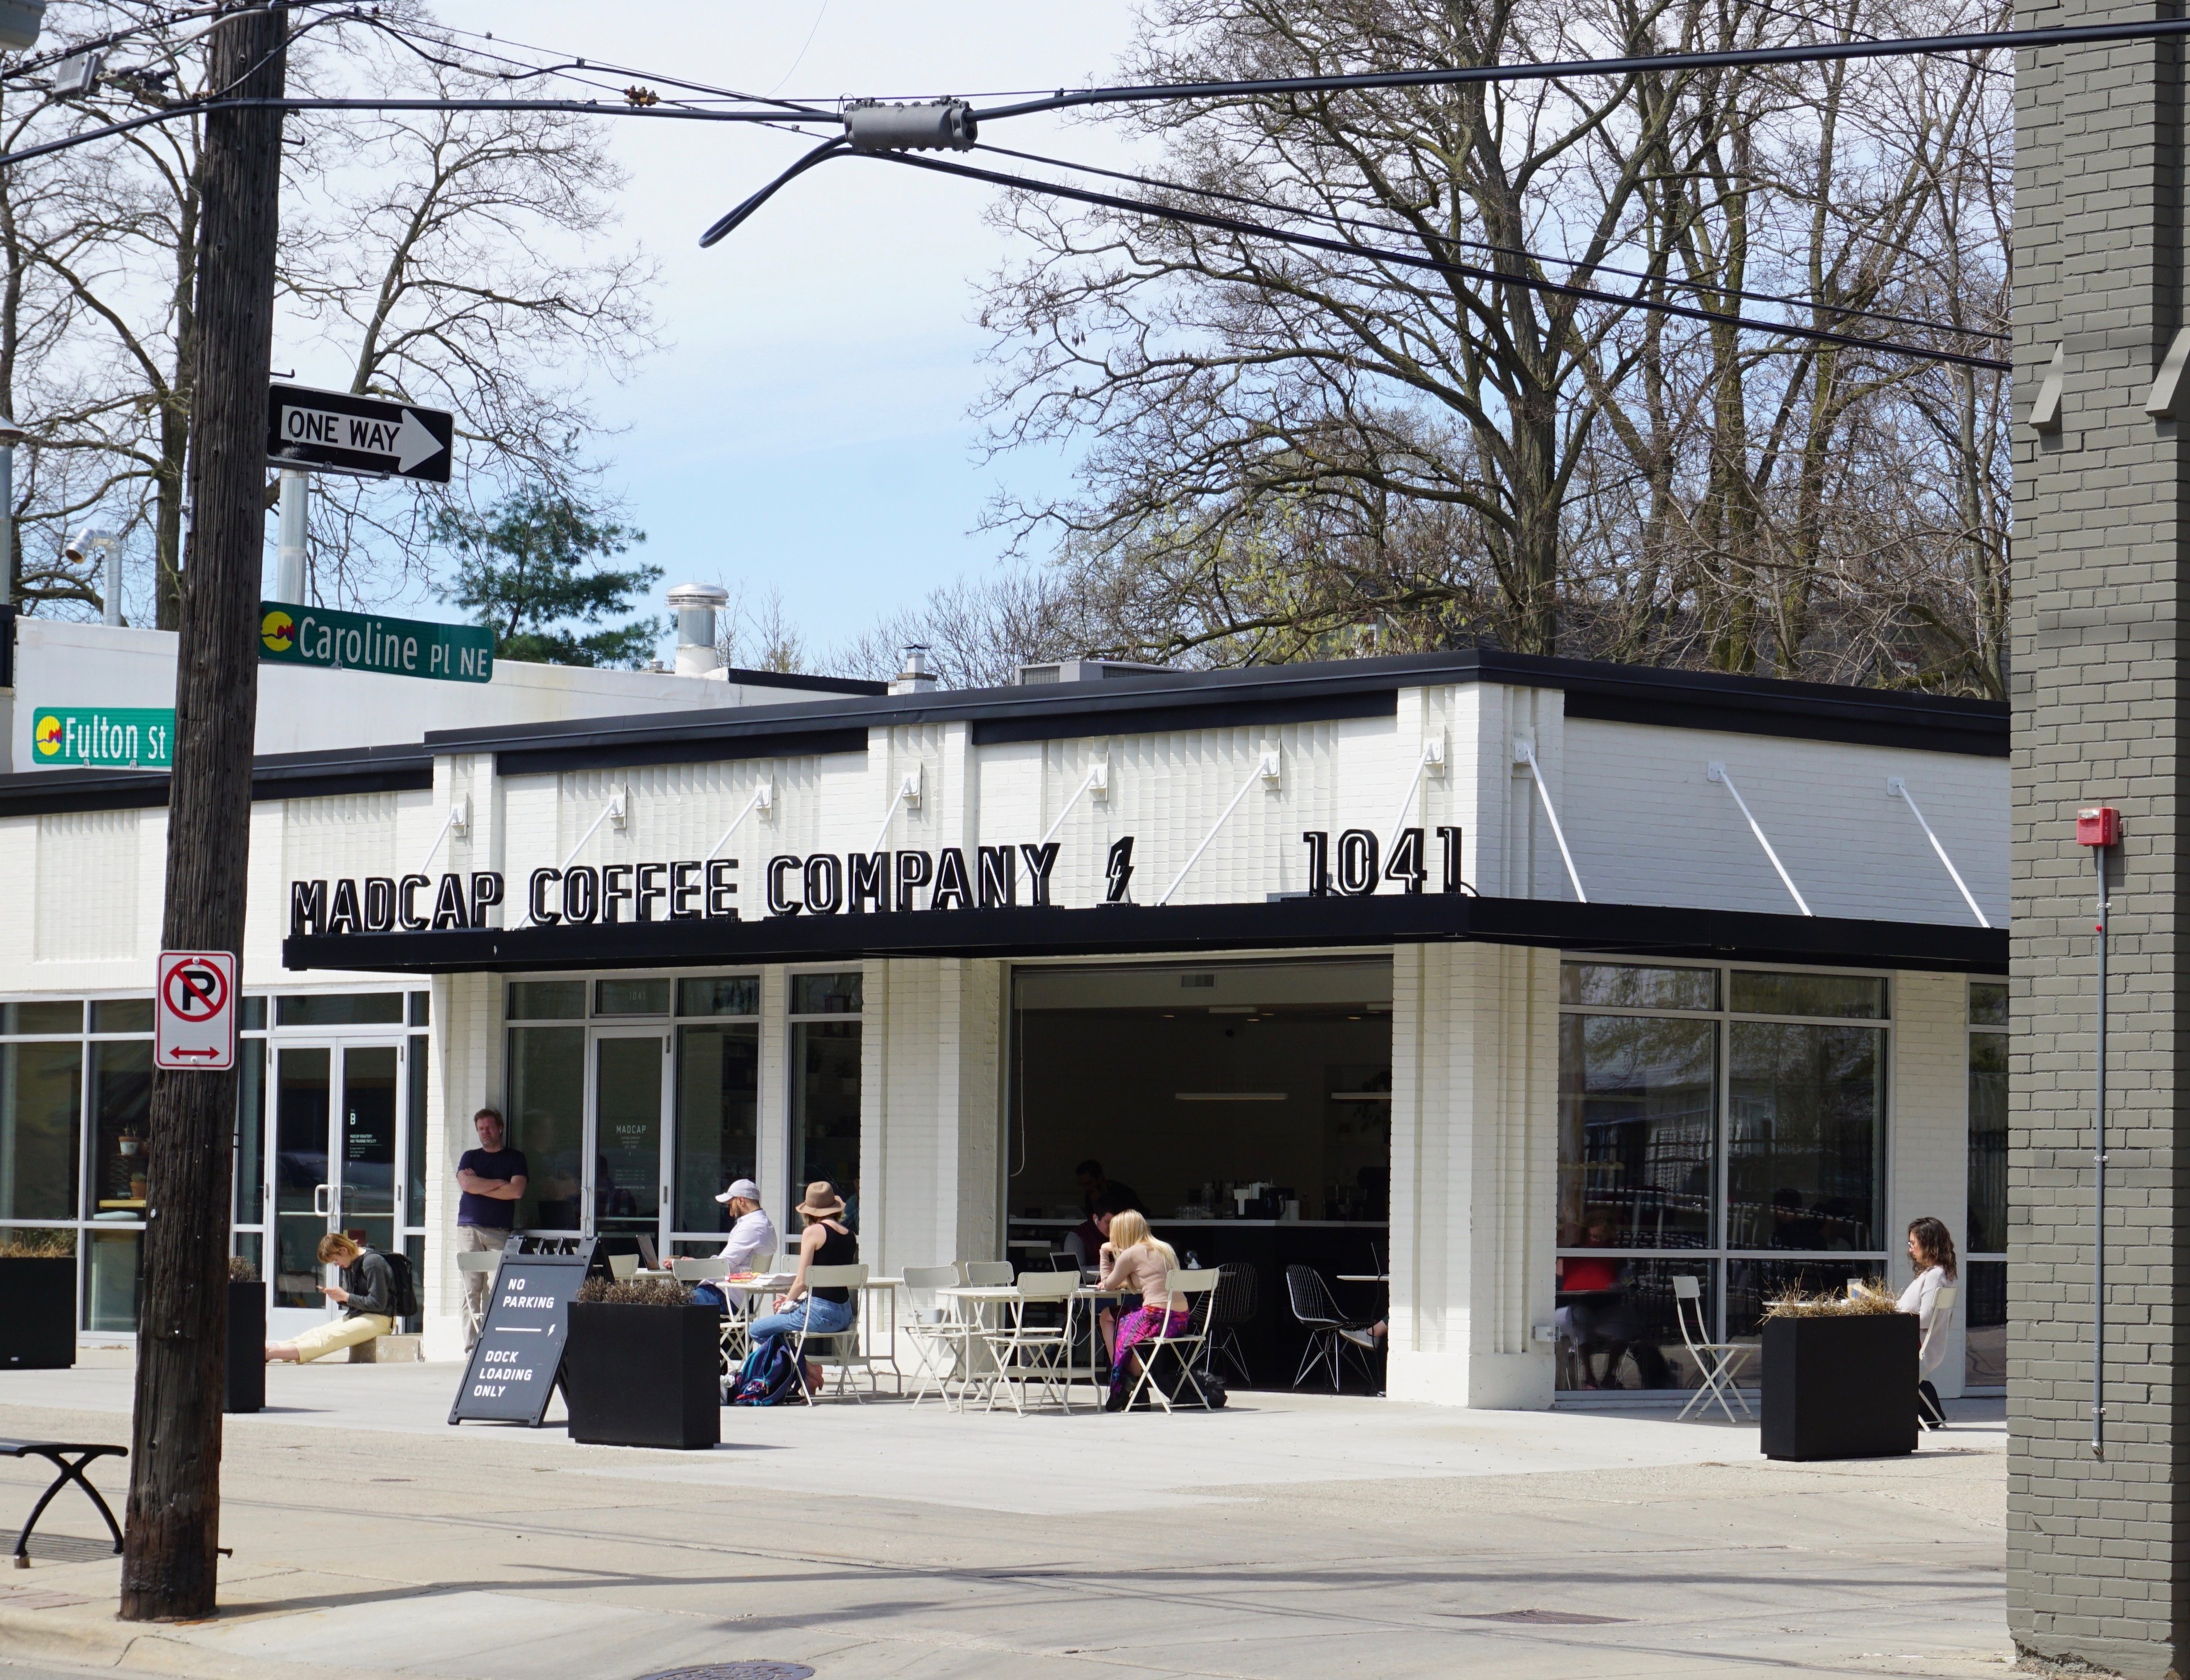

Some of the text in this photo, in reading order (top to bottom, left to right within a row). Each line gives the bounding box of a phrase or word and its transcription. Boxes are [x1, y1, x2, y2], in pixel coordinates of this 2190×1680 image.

[287, 410, 400, 452] ONE WAY
[299, 616, 488, 677] Caroline Pl NE
[66, 715, 165, 760] Fulton St
[1303, 827, 1462, 896] 1041
[291, 842, 1061, 935] MADCAP COFFEE COMPANY
[350, 1113, 356, 1125] B
[616, 1125, 646, 1134] MADCAP
[508, 1279, 525, 1291] NO
[502, 1296, 554, 1309] PARKING
[485, 1350, 519, 1363] DOCK
[479, 1367, 533, 1381] LOADING
[473, 1385, 506, 1397] ONLY
